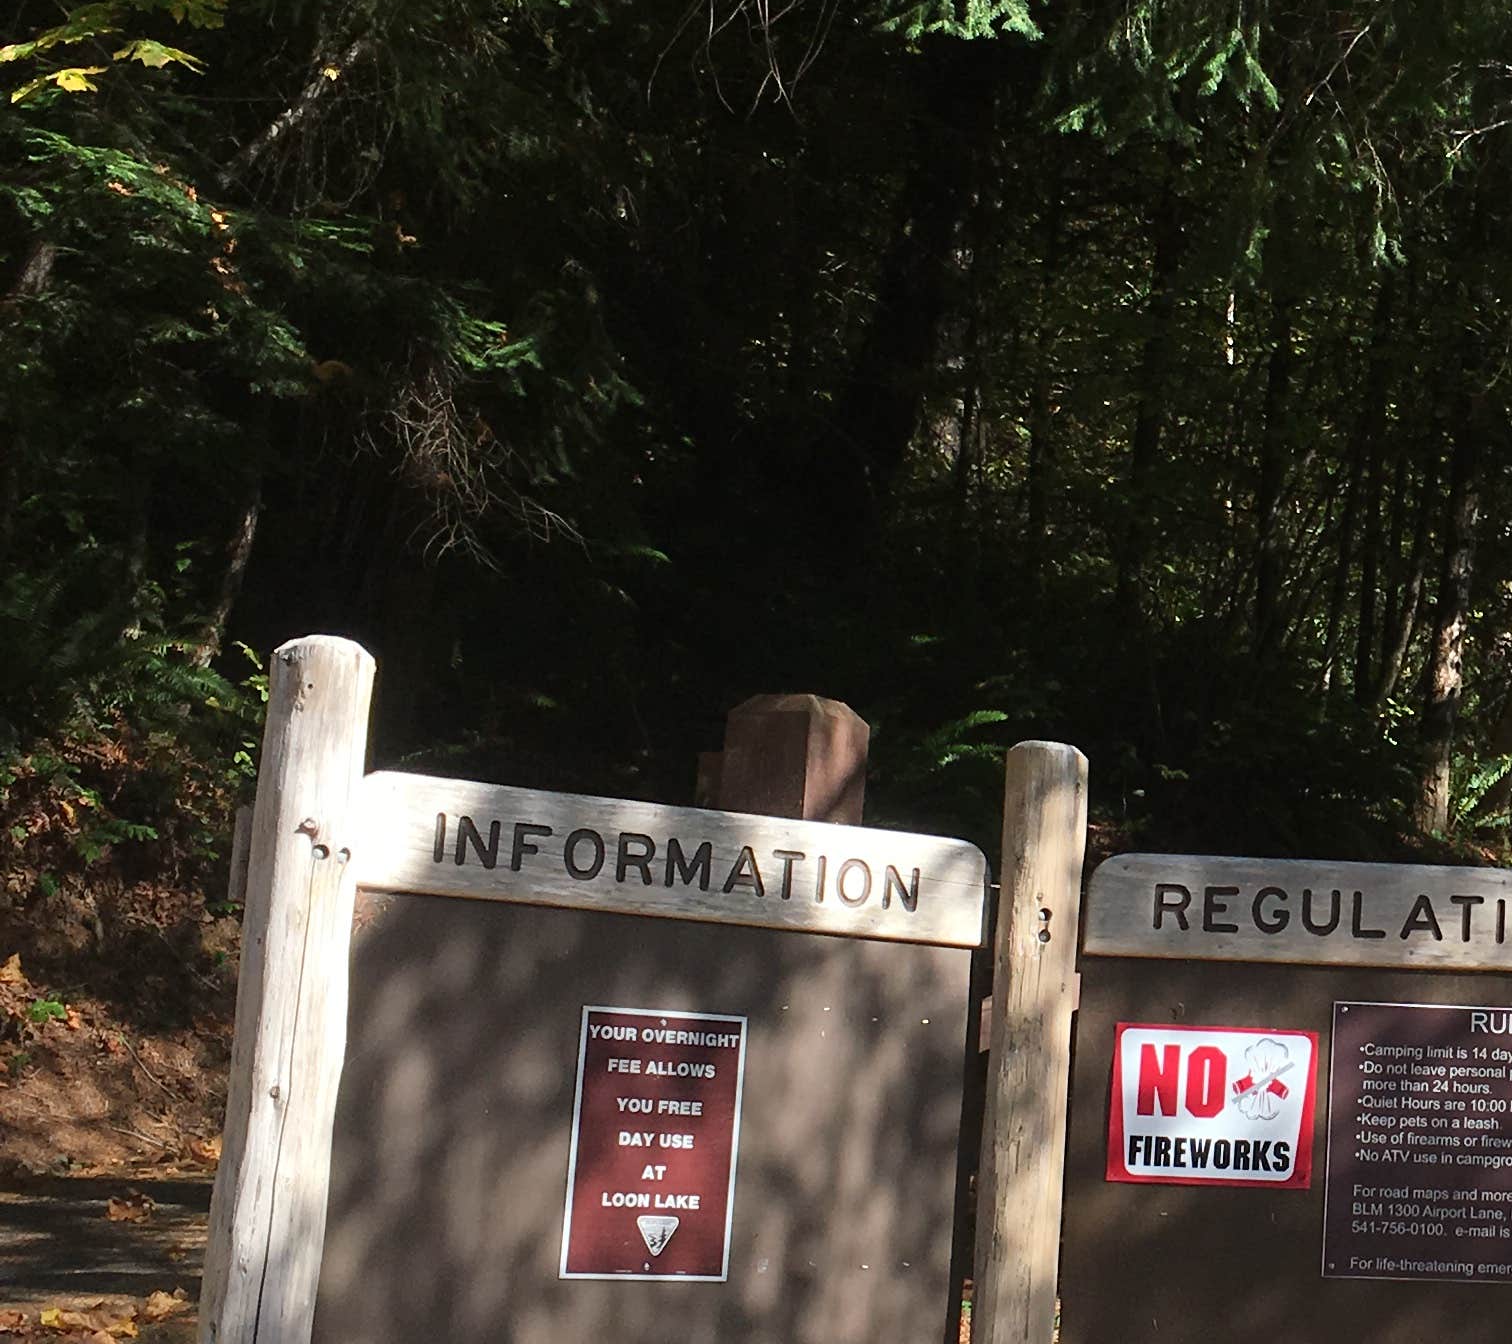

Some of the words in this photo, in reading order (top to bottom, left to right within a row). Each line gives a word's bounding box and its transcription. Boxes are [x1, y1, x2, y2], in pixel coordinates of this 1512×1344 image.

[433, 812, 921, 913] INFORMATION
[590, 1025, 637, 1041] YOUR
[642, 1029, 740, 1048] OVERNIGHT
[1364, 1043, 1423, 1060] Camping
[1427, 1046, 1453, 1058] limit
[1457, 1047, 1467, 1059] is
[1473, 1048, 1487, 1059] 14
[608, 1059, 641, 1073] FEE
[646, 1062, 716, 1078] ALLOWS
[1363, 1061, 1382, 1073] Do
[1387, 1064, 1407, 1074] not
[1411, 1064, 1446, 1076] leave
[1450, 1066, 1505, 1078] personal
[1136, 1043, 1227, 1118] NO
[1363, 1080, 1396, 1090] more
[1400, 1080, 1428, 1091] than
[1433, 1080, 1448, 1092] 24
[1453, 1082, 1492, 1094] hours.
[616, 1098, 653, 1113] YOU
[658, 1100, 703, 1116] FREE
[1362, 1095, 1397, 1109] Quiet
[1402, 1097, 1440, 1110] Hours
[1444, 1101, 1465, 1110] are
[1471, 1100, 1506, 1112] 10:00
[1361, 1113, 1396, 1128] Keep
[1400, 1116, 1427, 1128] pets
[1432, 1118, 1447, 1128] on
[1452, 1120, 1460, 1128] a
[619, 1132, 655, 1147] DAY
[660, 1134, 694, 1149] USE
[1361, 1131, 1386, 1144] Use
[1391, 1132, 1404, 1144] of
[1408, 1132, 1460, 1146] firearms
[1464, 1137, 1477, 1146] or
[1128, 1135, 1290, 1172] FIREWORKS
[1360, 1149, 1378, 1161] No
[1382, 1150, 1410, 1162] ATV
[1414, 1154, 1437, 1163] use
[1442, 1152, 1452, 1163] in
[642, 1166, 666, 1180] AT
[602, 1192, 650, 1207] LOON
[655, 1194, 700, 1210] LAKE
[1353, 1185, 1376, 1197] For
[1379, 1186, 1408, 1198] road
[1413, 1189, 1448, 1202] maps
[1453, 1189, 1477, 1200] and
[1352, 1203, 1382, 1215] BLM
[1388, 1204, 1419, 1217] 1300
[1423, 1206, 1466, 1220] Airport
[1471, 1207, 1506, 1221] Lane,
[1455, 1226, 1495, 1237] e-mail
[1500, 1226, 1509, 1238] is
[1351, 1257, 1372, 1269] For
[1376, 1258, 1473, 1276] life-threatening
